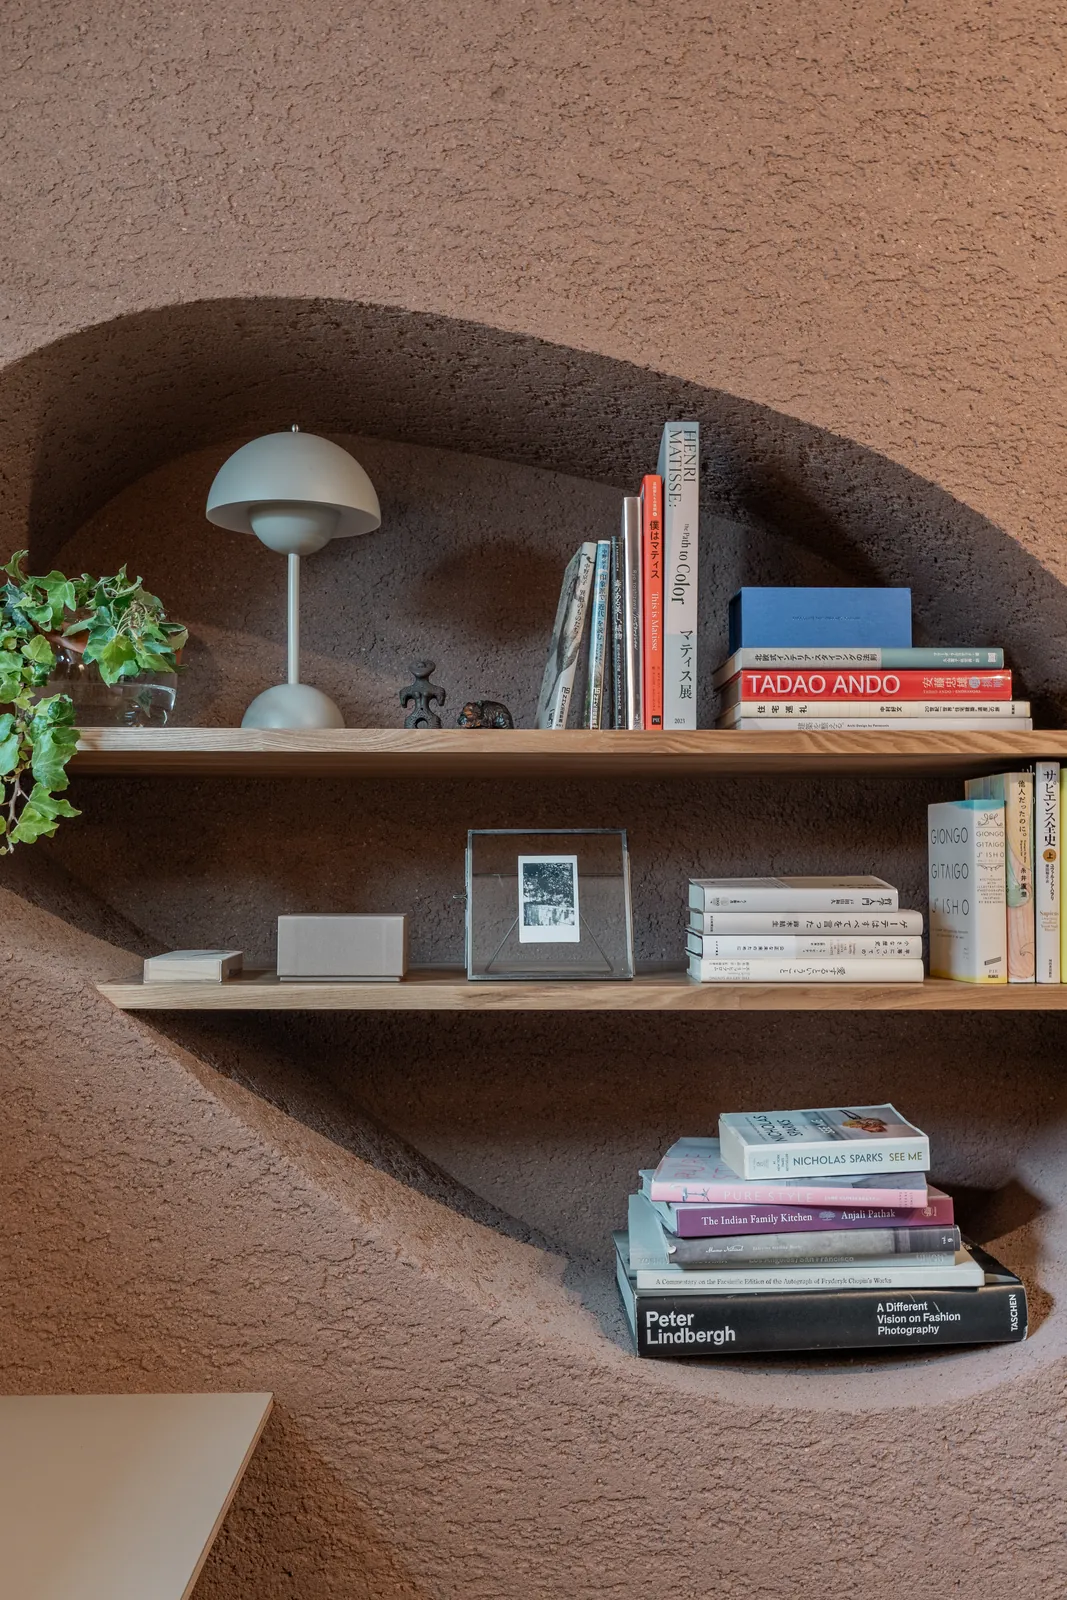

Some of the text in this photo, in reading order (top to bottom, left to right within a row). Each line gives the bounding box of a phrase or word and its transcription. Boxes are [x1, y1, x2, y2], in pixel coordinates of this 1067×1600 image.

[683, 430, 697, 482] HENRI
[668, 429, 682, 507] MATISSE:
[649, 519, 660, 578] 僕はマティス
[682, 532, 691, 549] Path
[678, 550, 689, 561] to
[671, 563, 690, 605] Color
[651, 591, 659, 610] This
[651, 619, 660, 651] Matisse
[678, 630, 693, 700] マティス展
[754, 653, 878, 662] 北欧式インテリア・スタイリングの法則
[747, 674, 900, 694] TADAO ANDO
[757, 705, 807, 713] 住宅巡礼
[1018, 780, 1027, 837] 他人だったのに。
[1043, 769, 1057, 847] サピエンス全史
[931, 827, 969, 845] GIONGO
[931, 863, 969, 879] GITAIGO
[861, 897, 893, 906] 哲学入門
[806, 919, 908, 928] ゲーテはすべてを言った
[779, 967, 846, 975] 愛するということ
[793, 1151, 923, 1165] NICHOLAS SPARKS SEE ME
[723, 1191, 761, 1201] PURE
[768, 1191, 812, 1202] STYLE
[701, 1209, 896, 1226] The Indian Family Kitchen Anjali Pathak
[662, 1278, 697, 1286] Commentary
[784, 1278, 812, 1286] Autograph
[821, 1277, 847, 1286] Fryderyk
[848, 1277, 872, 1285] Chopin's
[877, 1301, 928, 1313] A Different
[1008, 1293, 1018, 1332] TASCHEN
[646, 1311, 694, 1328] Peter
[877, 1312, 961, 1325] Vision on Fashion
[646, 1325, 736, 1346] Lindbergh
[877, 1324, 940, 1336] Photography
